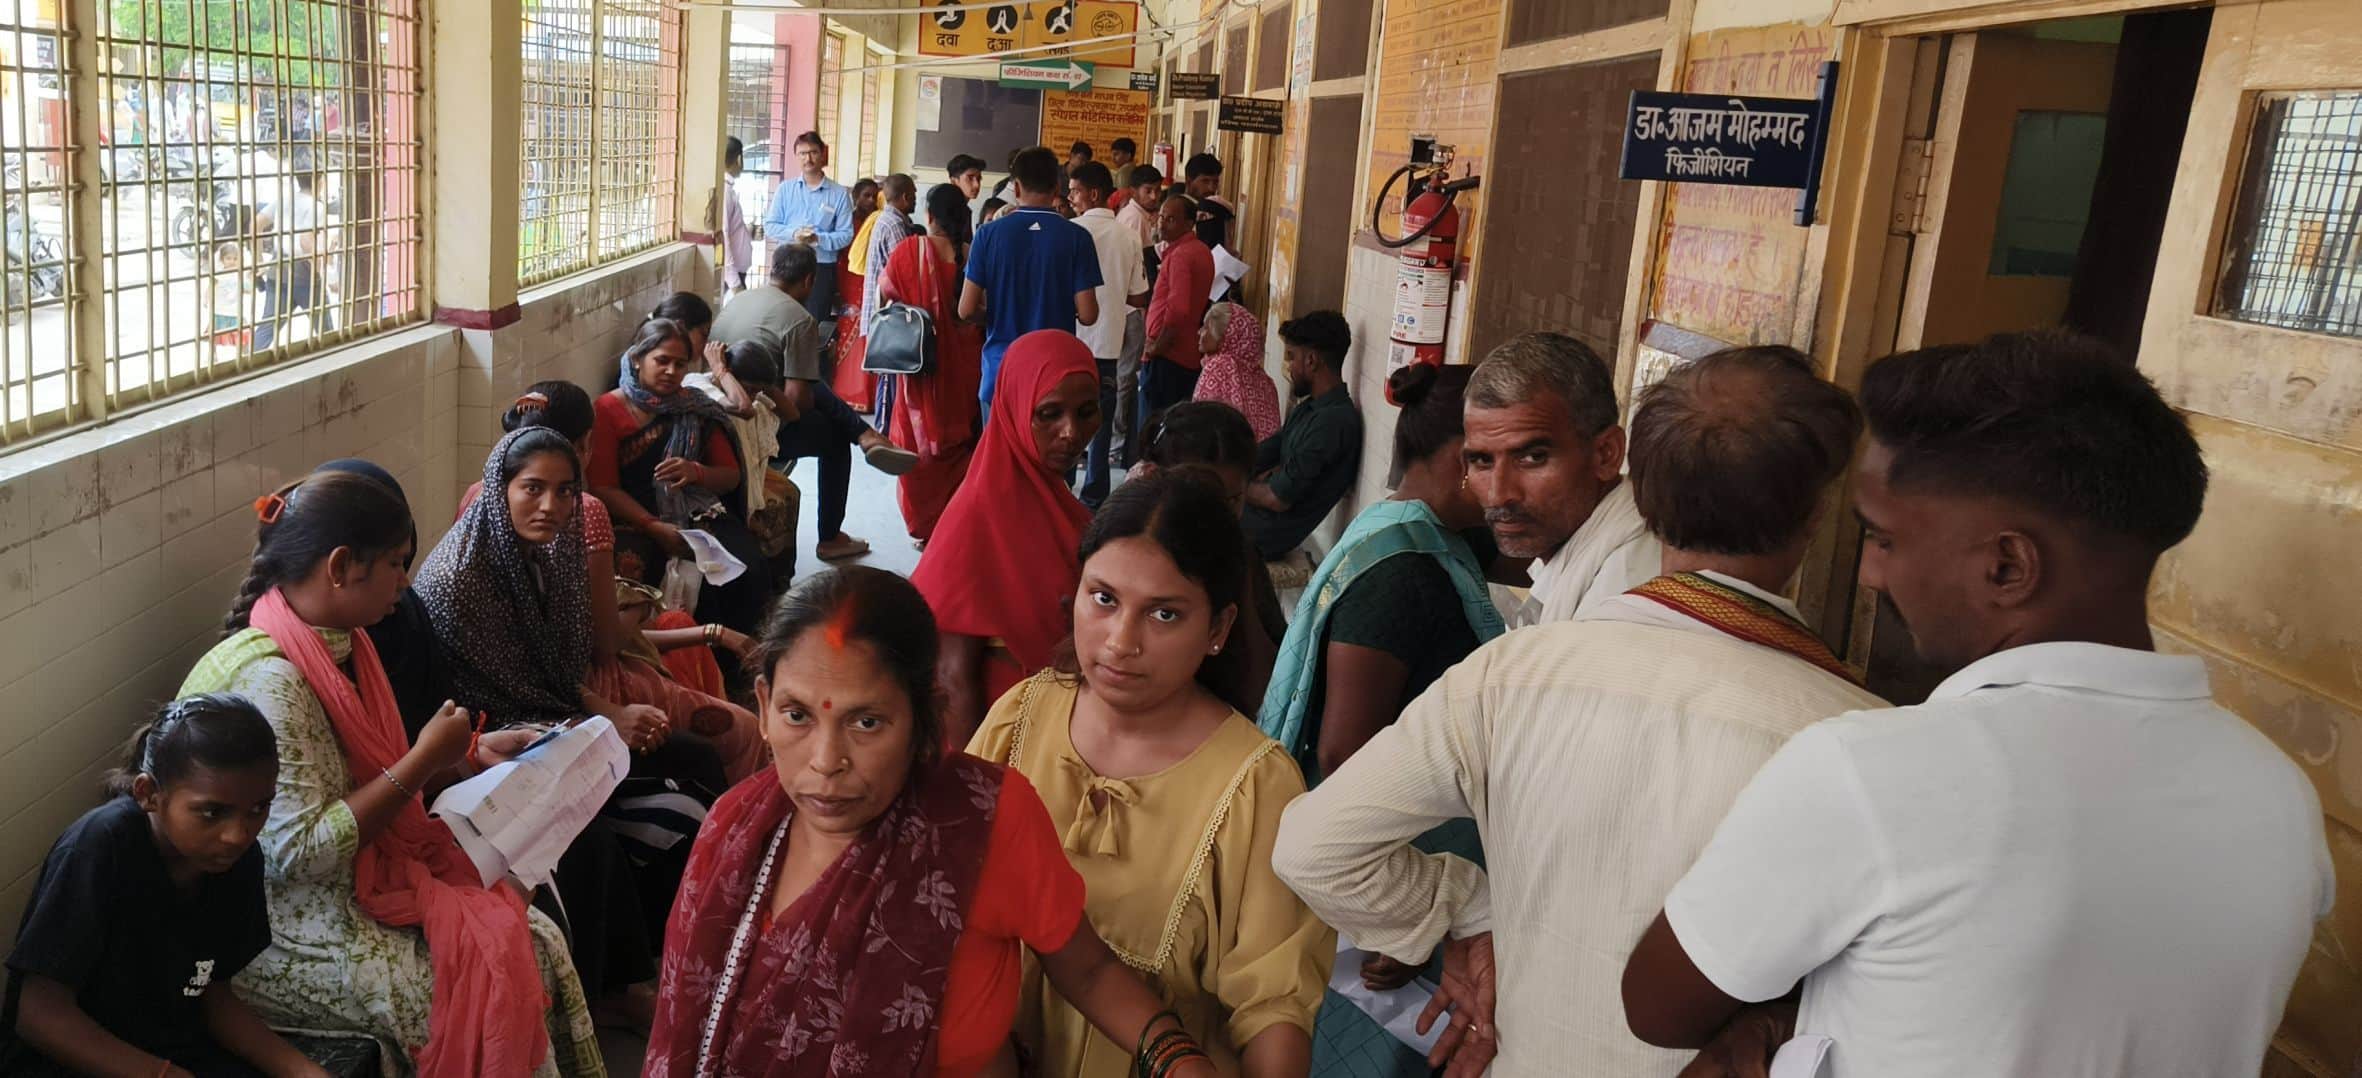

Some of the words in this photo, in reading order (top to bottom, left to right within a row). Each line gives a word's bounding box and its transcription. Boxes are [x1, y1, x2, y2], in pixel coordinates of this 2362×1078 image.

[936, 33, 960, 48] दवा
[1728, 99, 1809, 150] मोहम्मद
[1665, 147, 1754, 178] फिजीशियन
